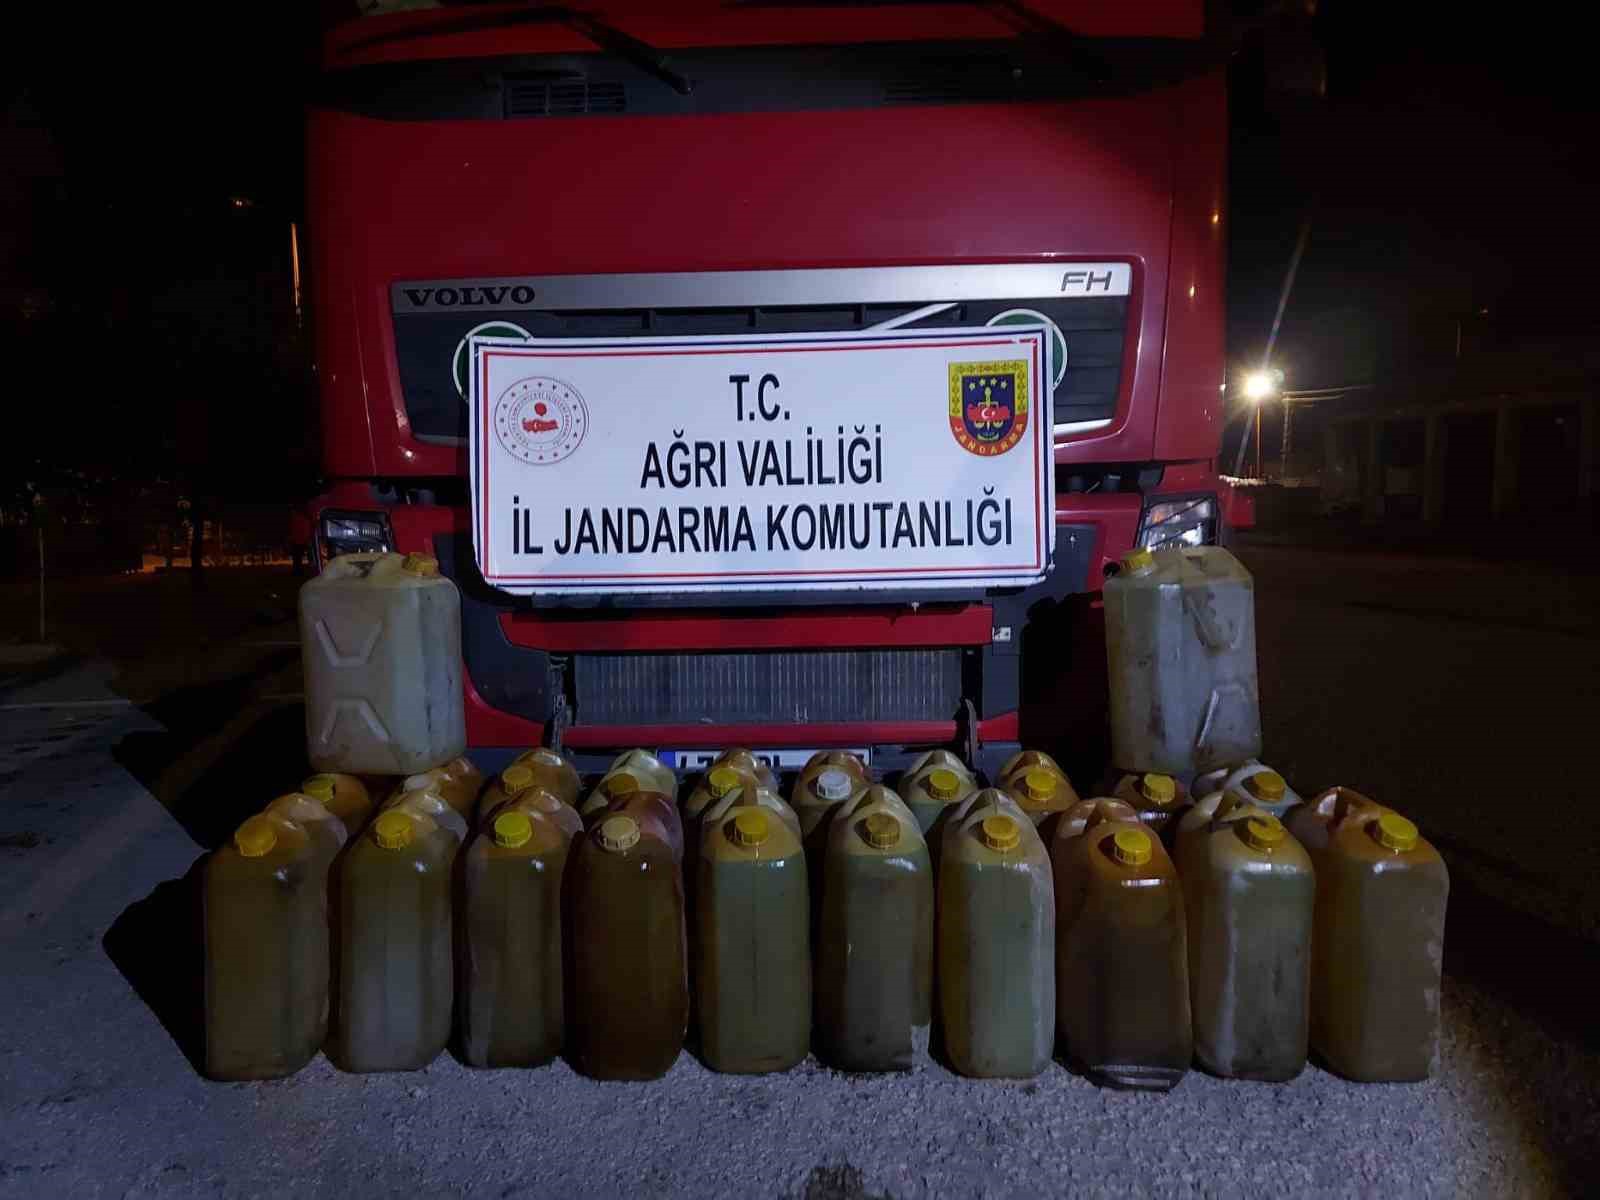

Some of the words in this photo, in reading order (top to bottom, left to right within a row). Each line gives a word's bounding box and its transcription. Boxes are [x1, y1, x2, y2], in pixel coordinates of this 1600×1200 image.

[403, 286, 535, 306] VOLVO
[1061, 270, 1113, 292] FH
[729, 373, 790, 421] T.C.
[640, 429, 726, 489] AĞRI
[737, 424, 882, 487] VALİLİĞİ
[954, 424, 1024, 455] JANDARMA
[512, 495, 542, 554] İL
[554, 504, 755, 555] JANDARMA
[766, 485, 1012, 551] KOMUTANLIĞI
